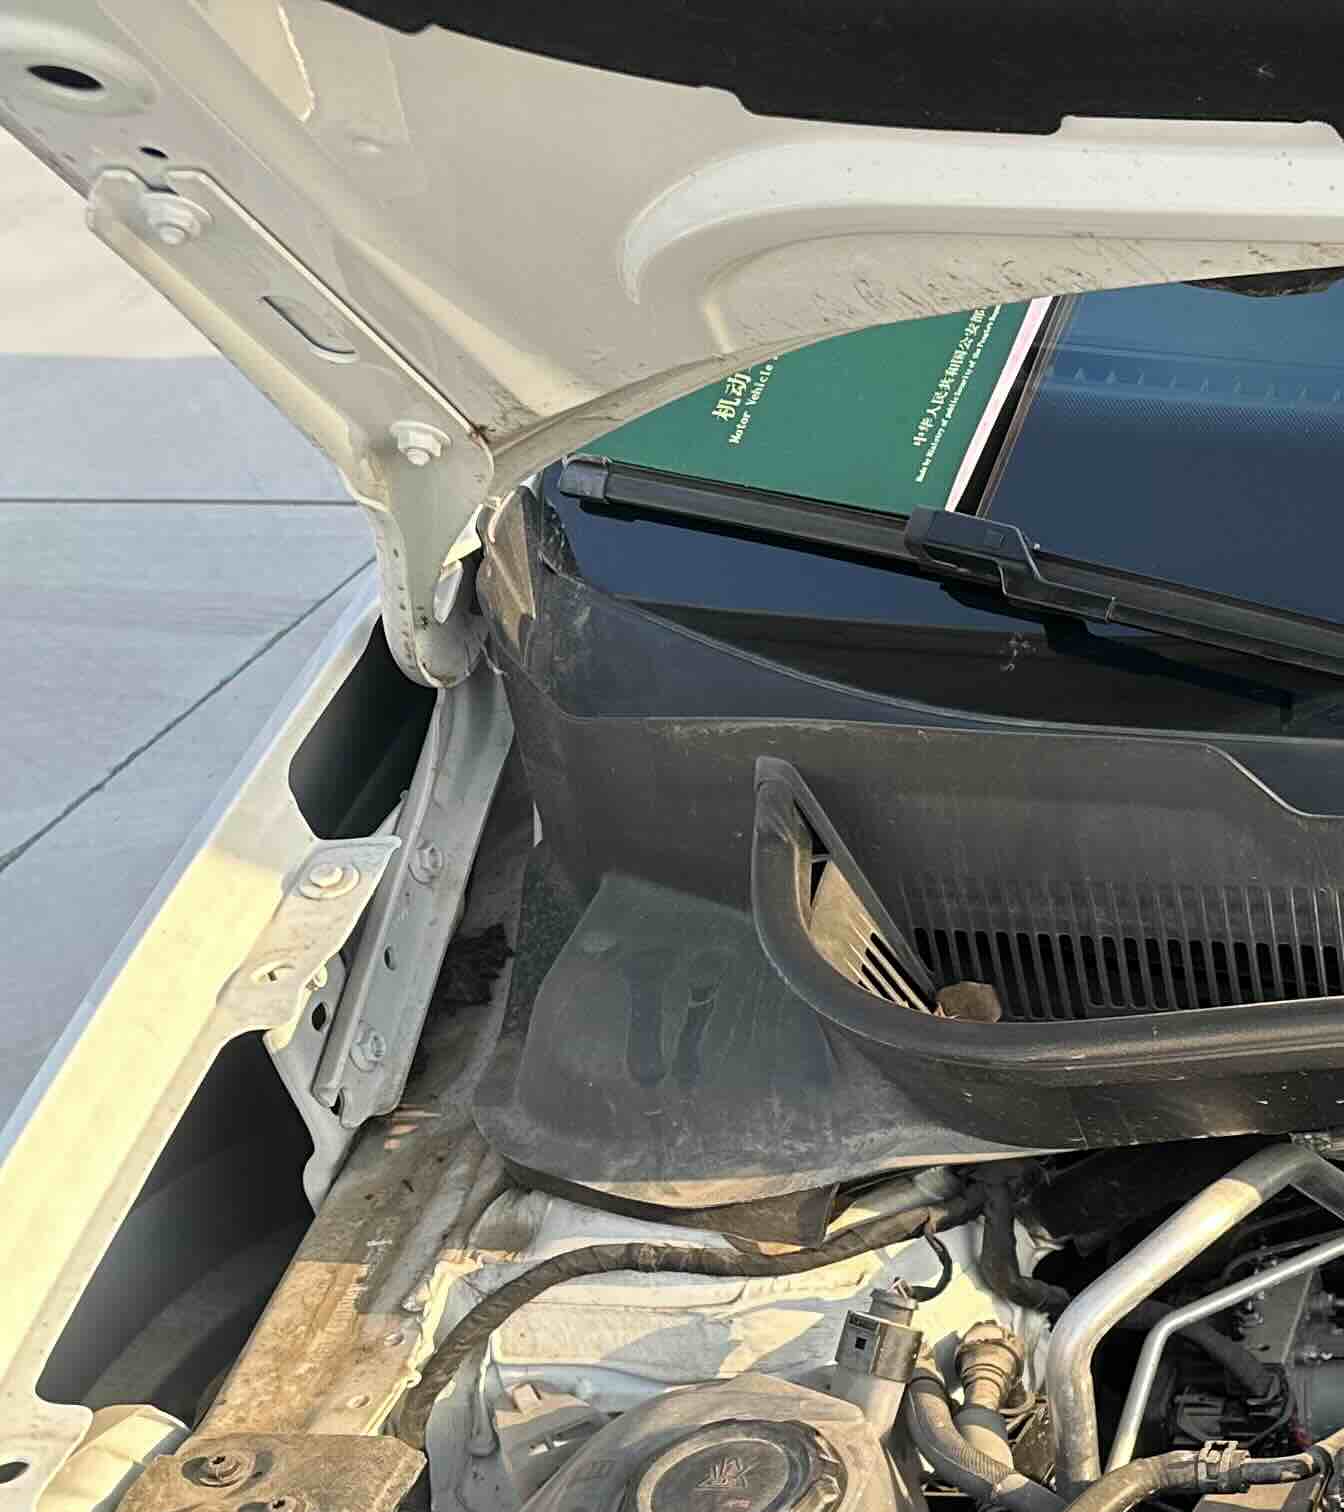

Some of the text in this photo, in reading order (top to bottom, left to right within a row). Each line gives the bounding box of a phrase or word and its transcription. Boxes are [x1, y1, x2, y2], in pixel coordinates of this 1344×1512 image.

[712, 367, 752, 421] 机动
[728, 364, 774, 444] Motor Vehicle
[912, 305, 987, 446] 中华人民共和国公安部
